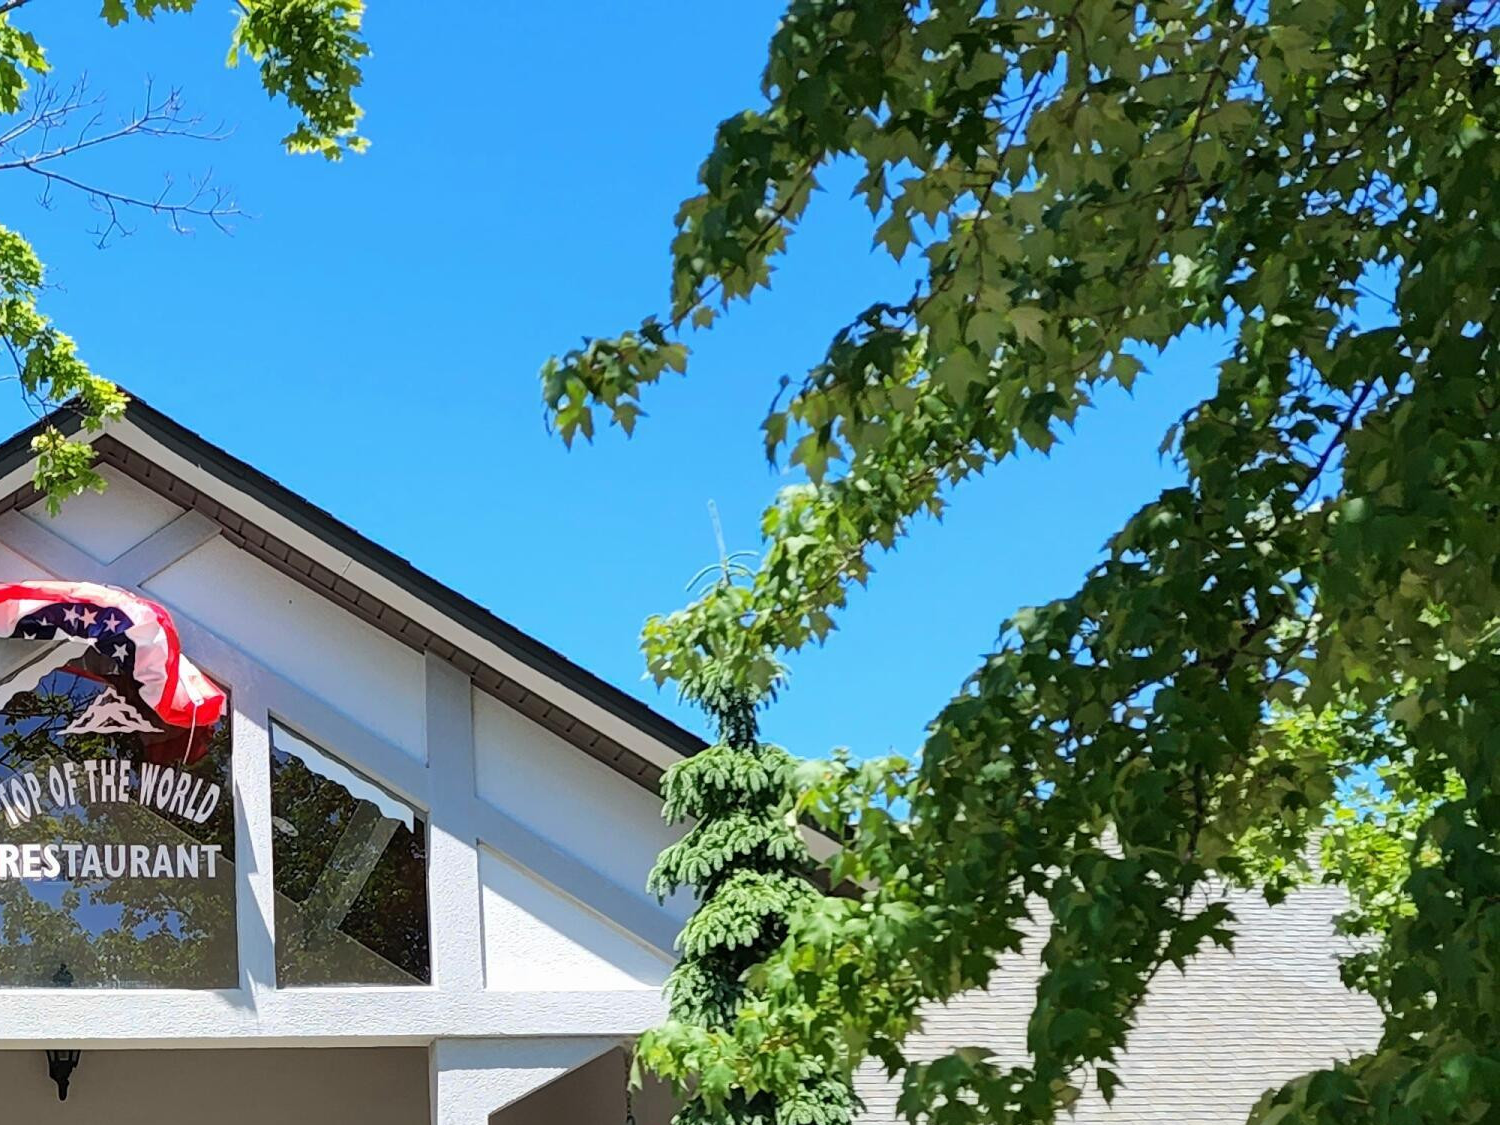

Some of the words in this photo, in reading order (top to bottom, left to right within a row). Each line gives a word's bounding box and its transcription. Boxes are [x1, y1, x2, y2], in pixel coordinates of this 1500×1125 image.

[50, 762, 78, 808] OF
[84, 760, 131, 803] THE
[140, 762, 221, 824] WORLD
